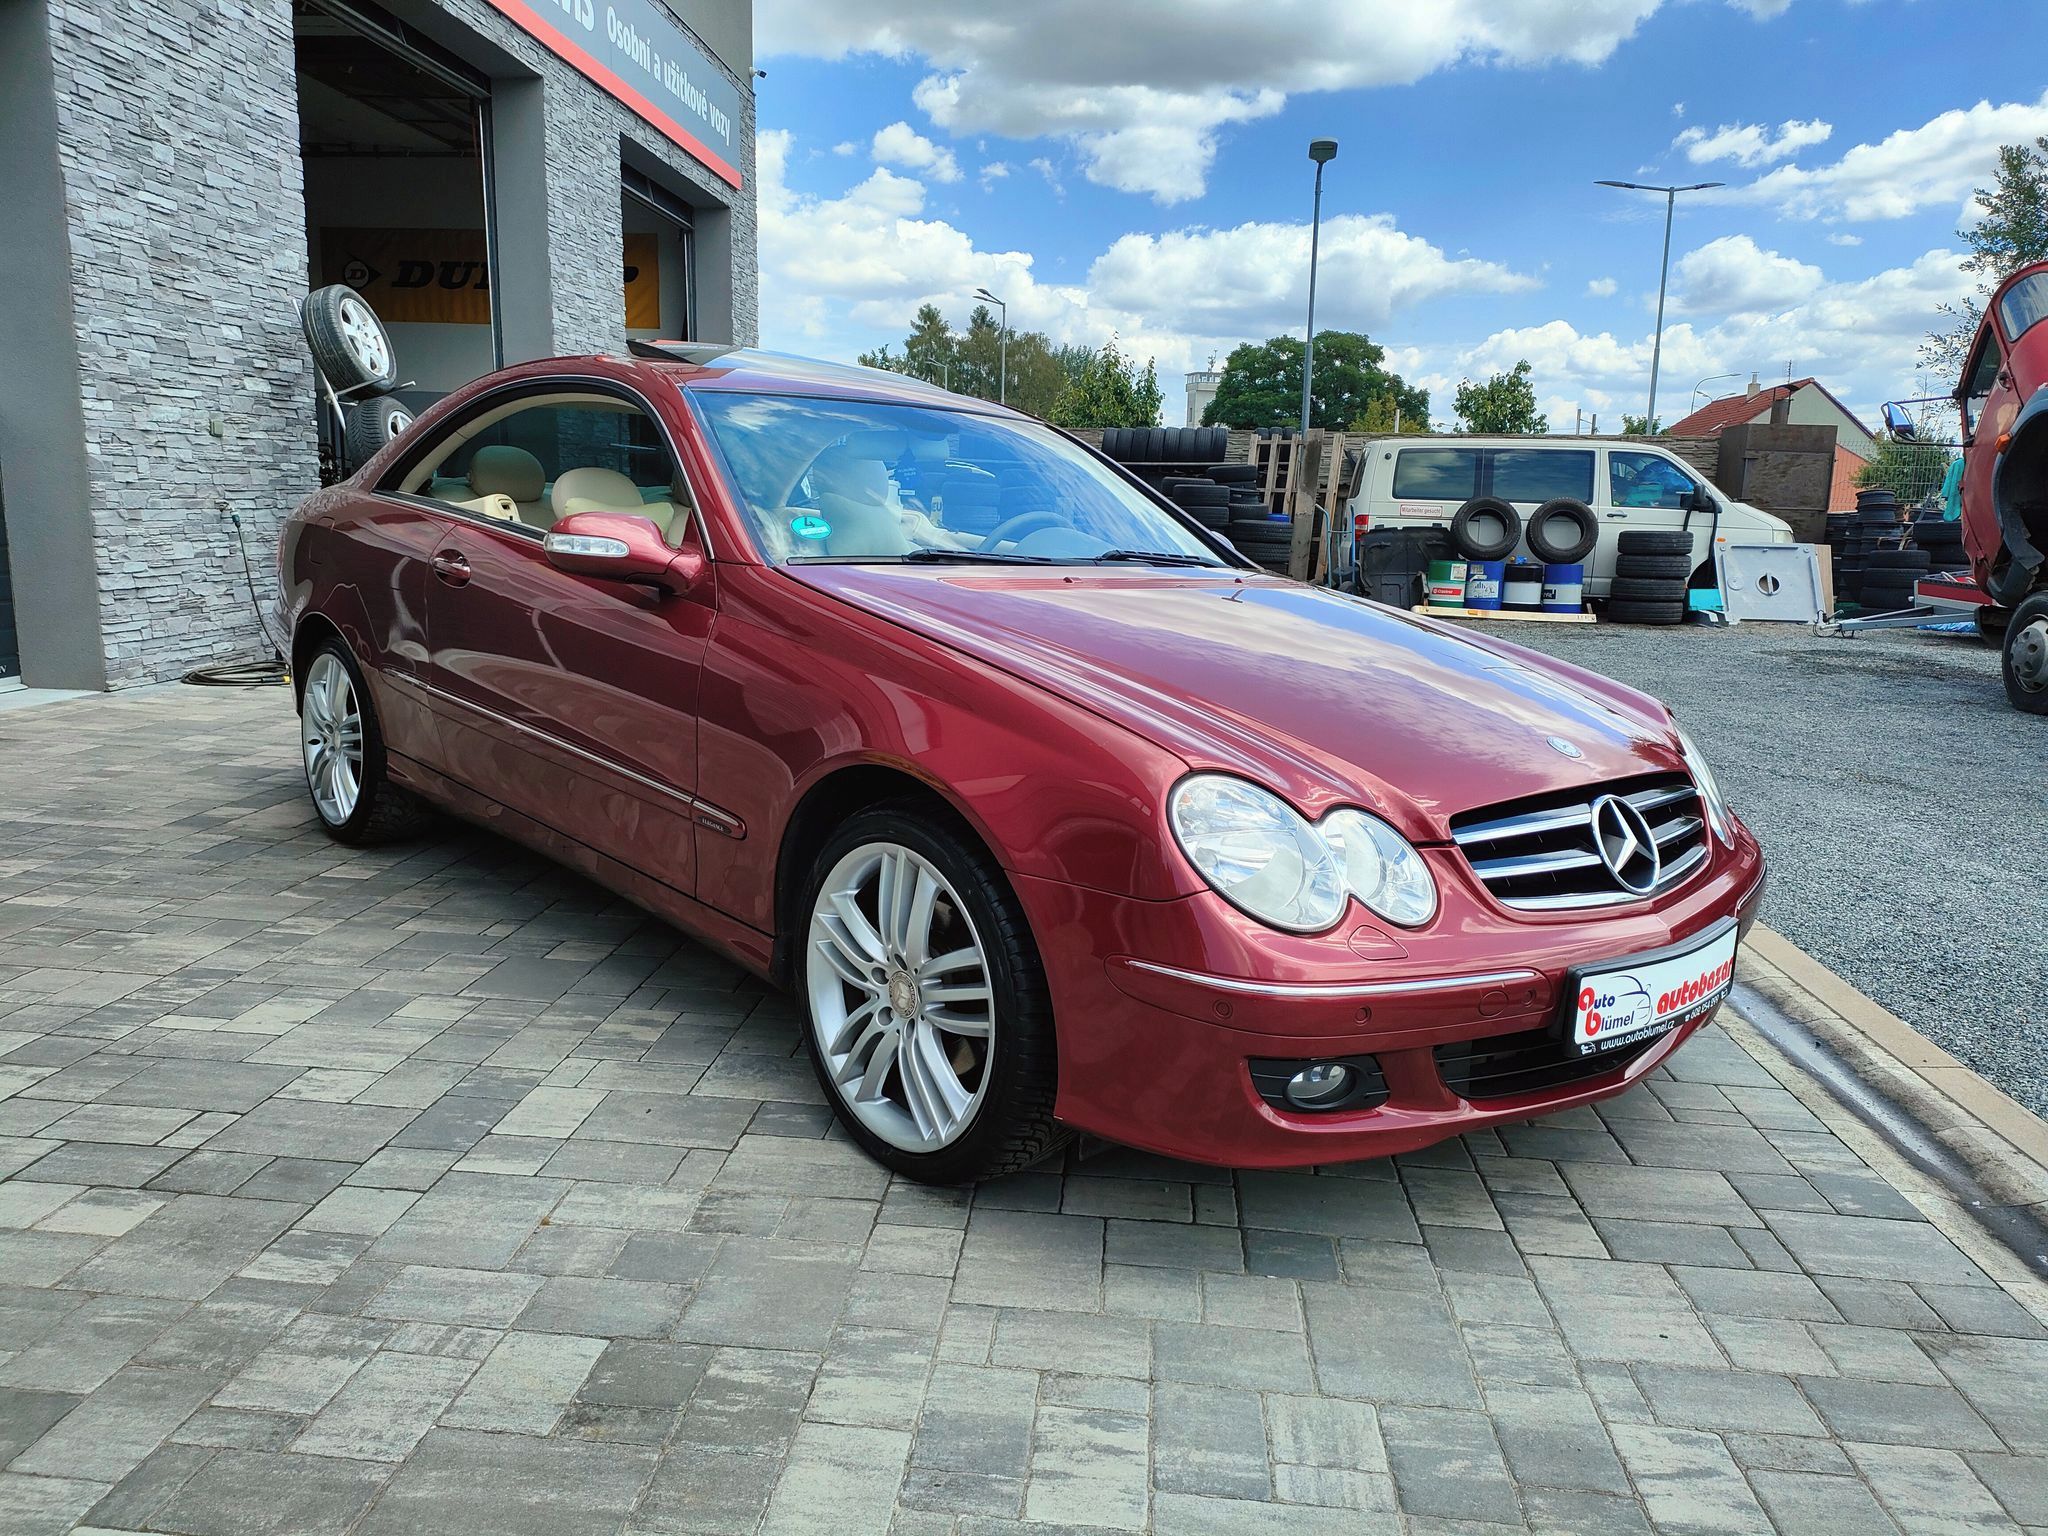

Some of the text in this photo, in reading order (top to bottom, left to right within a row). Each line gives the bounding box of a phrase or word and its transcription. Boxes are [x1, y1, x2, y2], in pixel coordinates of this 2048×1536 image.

[607, 6, 651, 74] Osobní
[653, 52, 661, 82] a
[664, 58, 708, 121] užitkové
[709, 102, 731, 146] vozy
[1656, 957, 1734, 1015] autobazar
[1601, 1020, 1675, 1051] www.autoblumel.cz
